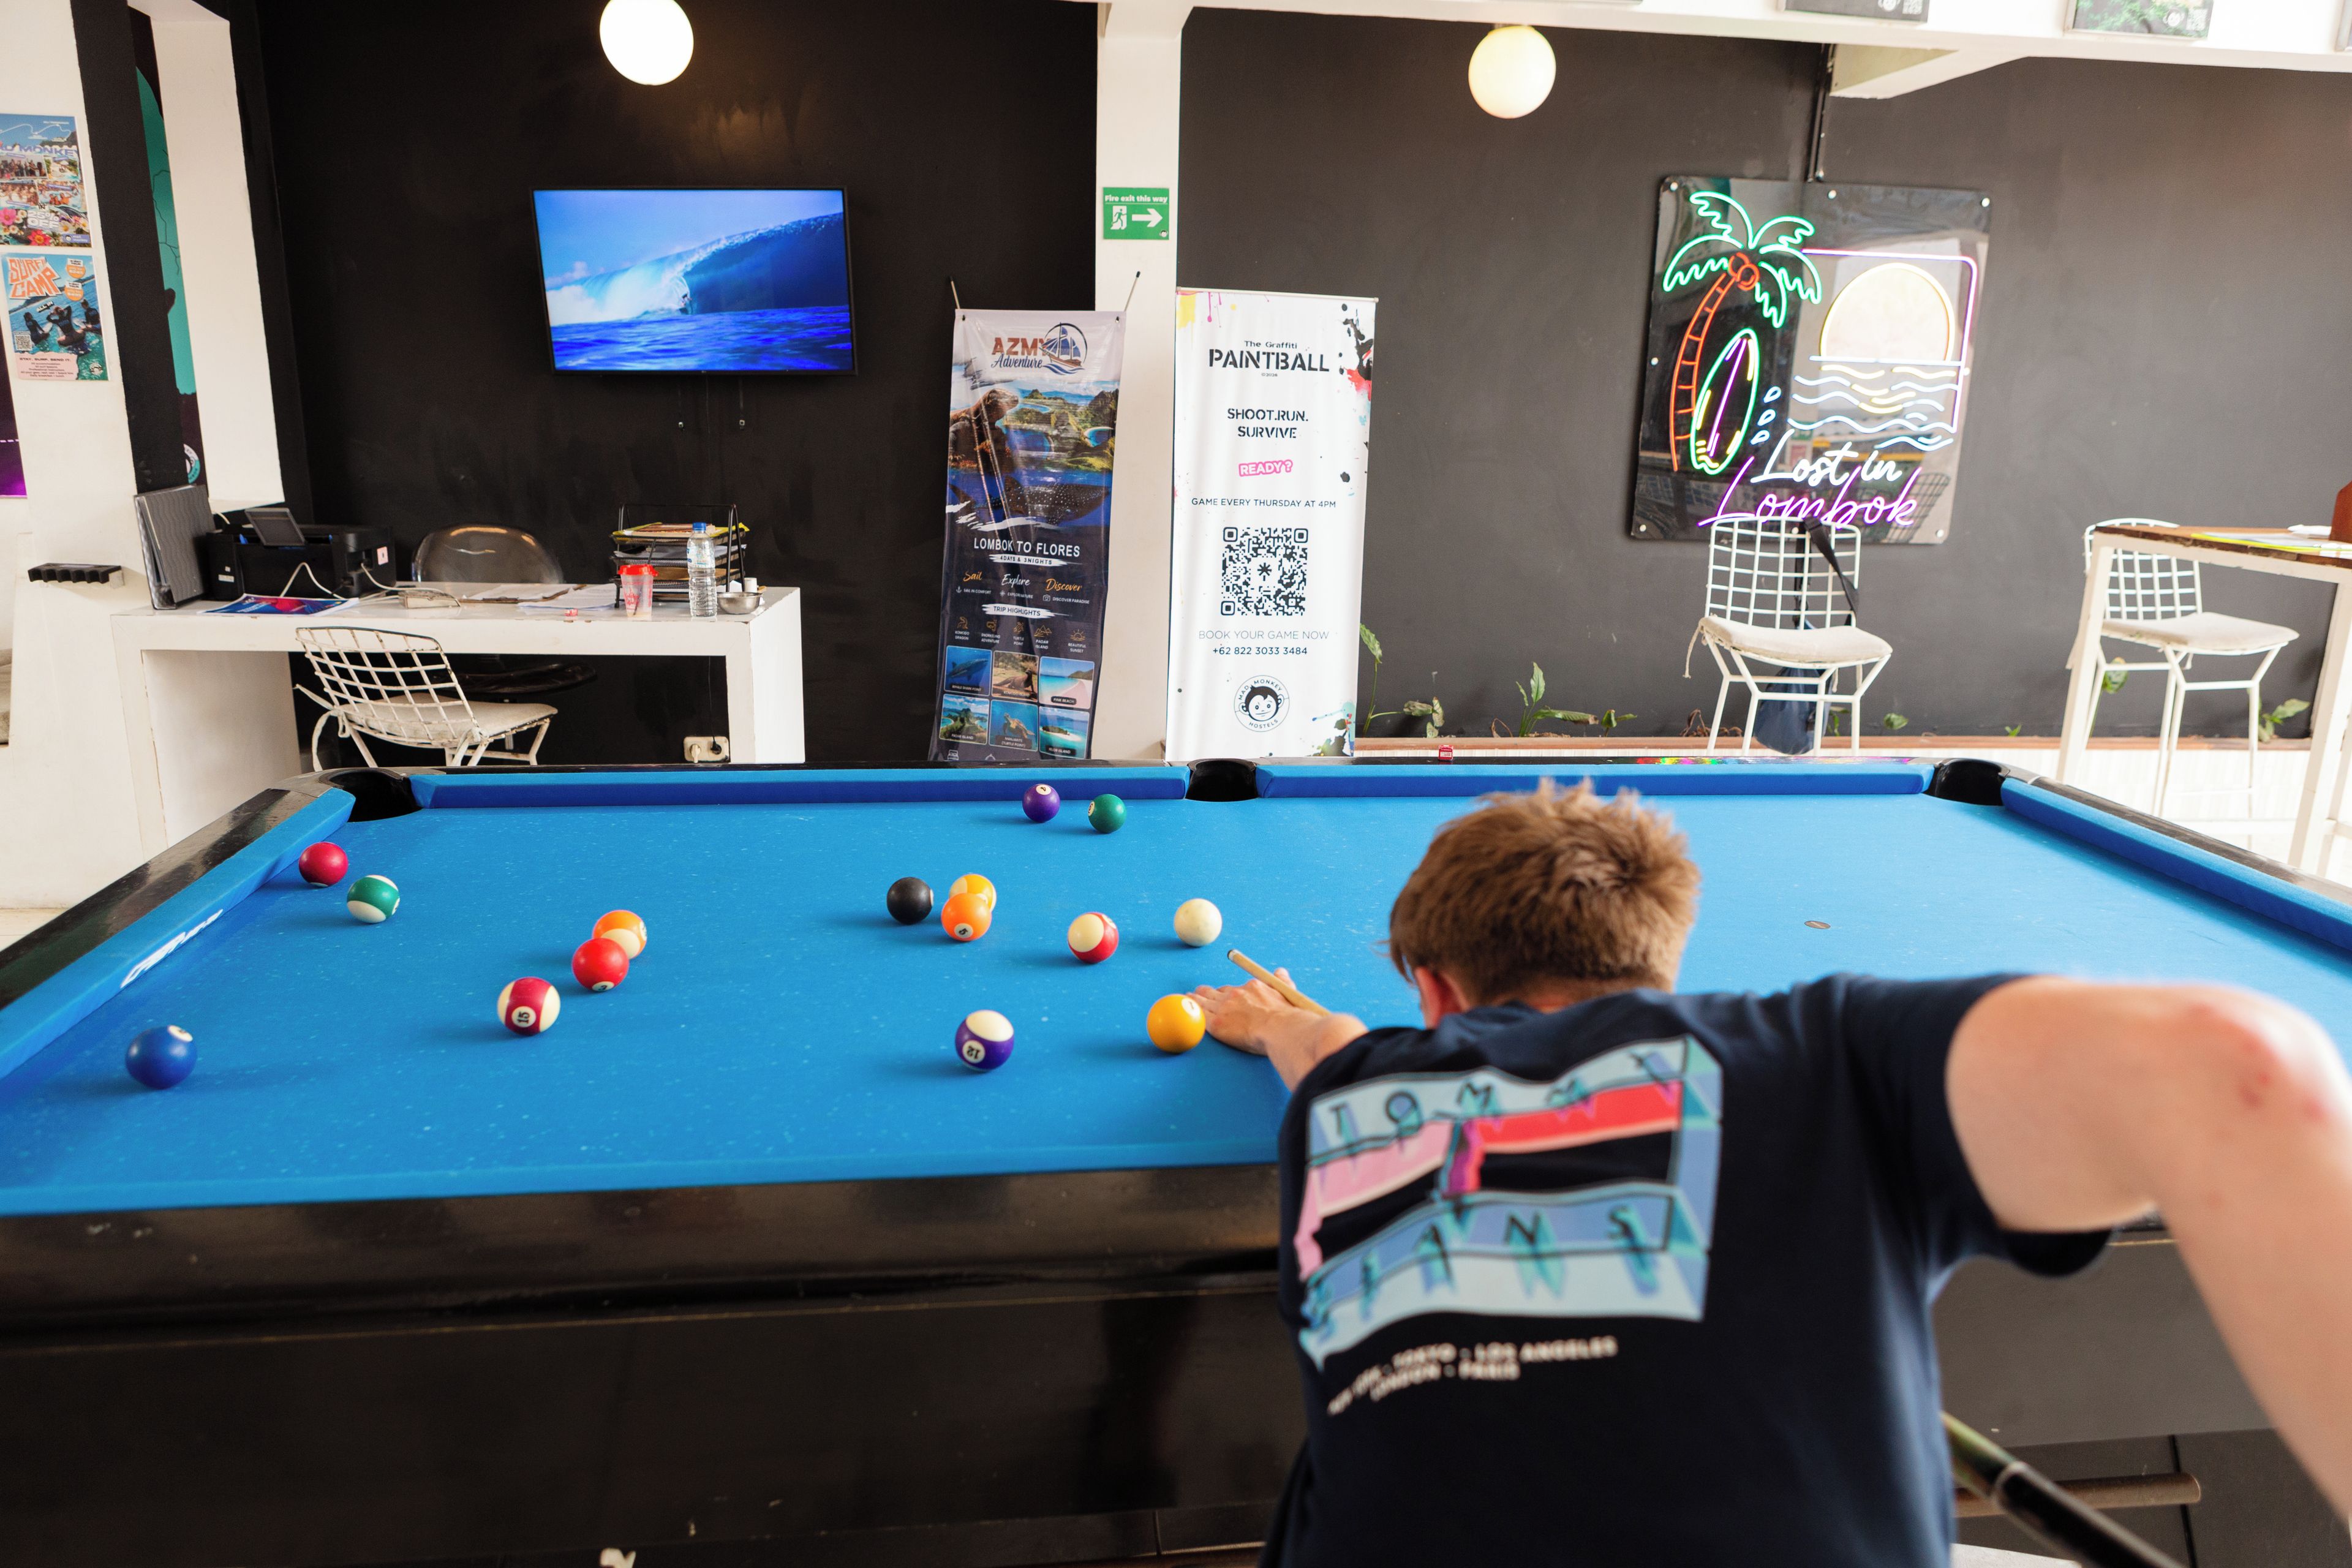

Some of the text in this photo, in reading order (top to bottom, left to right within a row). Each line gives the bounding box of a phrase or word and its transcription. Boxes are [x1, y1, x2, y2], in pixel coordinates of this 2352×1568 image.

[11, 266, 61, 298] CAMP
[992, 337, 1052, 356] AZMY
[991, 353, 1043, 368] Adventure
[1209, 349, 1330, 372] PAINTBALL
[1227, 408, 1308, 421] SHOOT.RUN.
[1238, 426, 1297, 438] SURVIVE
[1750, 429, 1902, 486] Lost in
[1697, 456, 1923, 530] Lombok
[974, 538, 1080, 557] LOMBOK TO FLORES
[963, 571, 982, 582] Sail
[1001, 573, 1031, 588] Explore
[1045, 578, 1082, 592] Discover
[1008, 606, 1041, 616] HIGHLIGHTS
[1199, 630, 1329, 639] BOOK YOUR GAME NOW
[1238, 679, 1282, 700] MAD MONKEY
[1249, 719, 1278, 729] HOSTELS
[517, 1011, 530, 1023] 15
